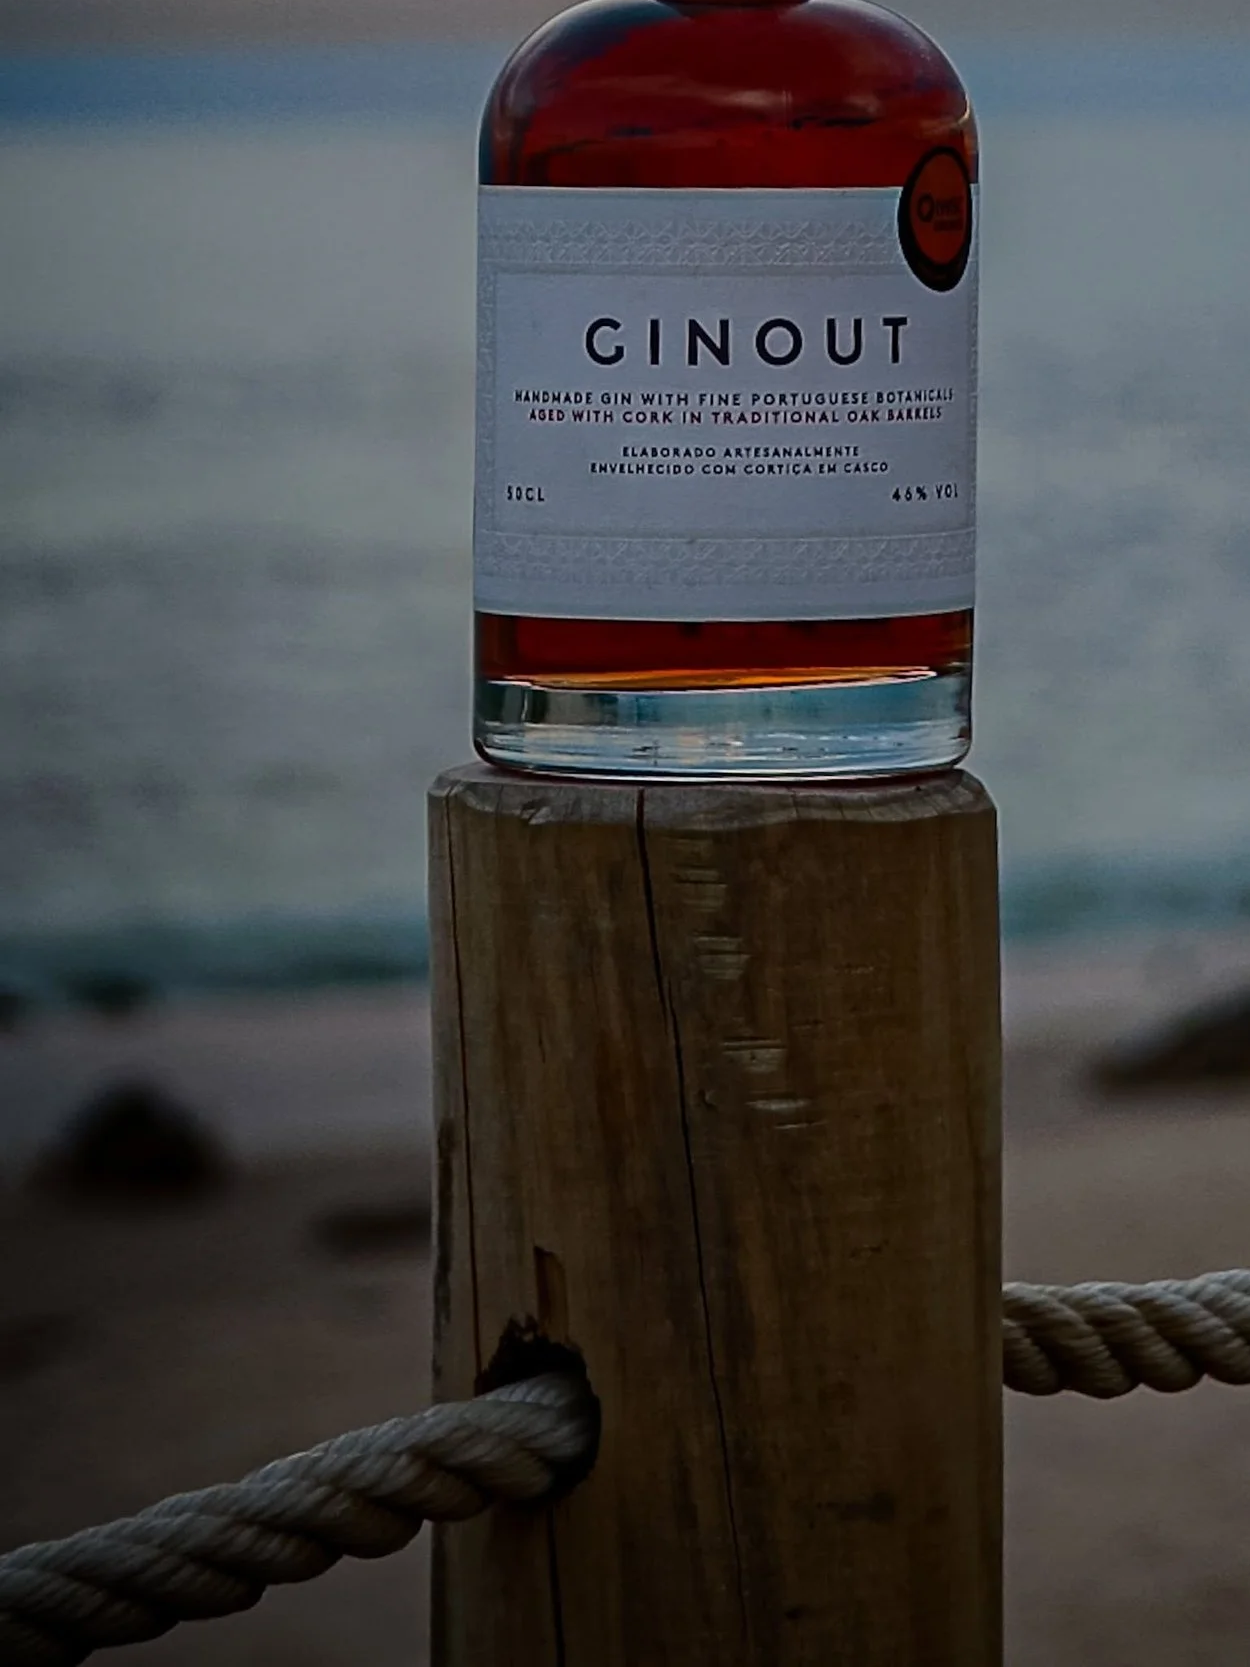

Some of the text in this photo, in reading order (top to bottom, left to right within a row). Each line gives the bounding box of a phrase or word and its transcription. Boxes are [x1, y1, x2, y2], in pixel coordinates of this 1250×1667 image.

[585, 317, 908, 366] GINOUT
[515, 388, 953, 406] HANDMADE GIN WITH FINE PORTUGUESE BOTANICALS
[529, 406, 943, 425] AGED WITH CORK IN TRADITIONAL OAK BARRELS
[622, 445, 860, 458] ELABORADO ARTESANALMENTE
[590, 461, 888, 476] ENVELHECIDO COM CORTIÇA EM CASCO
[507, 486, 545, 502] 50CL
[892, 485, 928, 502] 46%
